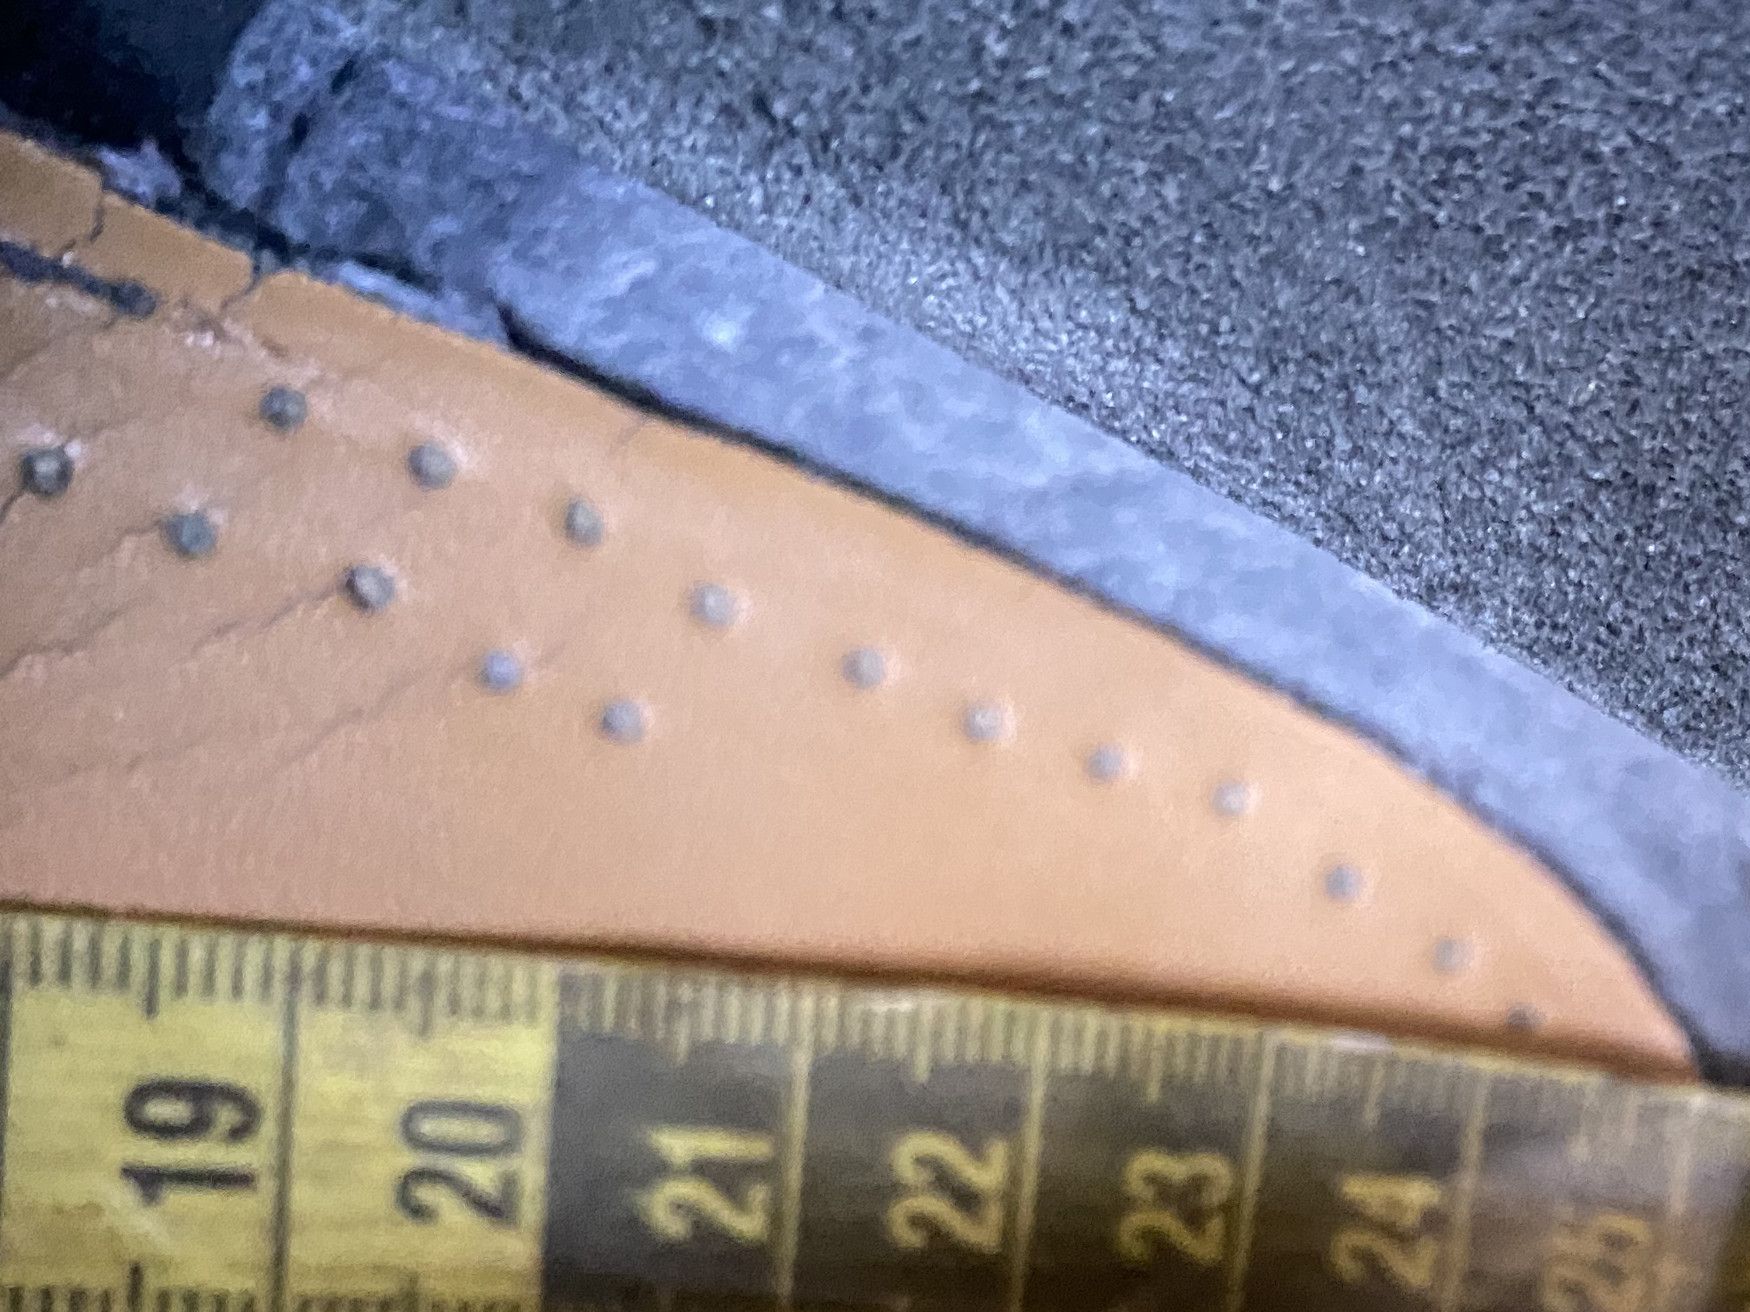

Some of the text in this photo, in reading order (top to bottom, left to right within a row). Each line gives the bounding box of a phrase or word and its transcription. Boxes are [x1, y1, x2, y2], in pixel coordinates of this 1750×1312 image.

[120, 1078, 262, 1205] 19
[397, 1100, 520, 1224] 20
[640, 1126, 774, 1242] 21
[887, 1131, 1006, 1252] 22
[1119, 1149, 1232, 1264] 23
[1330, 1173, 1441, 1289] 24
